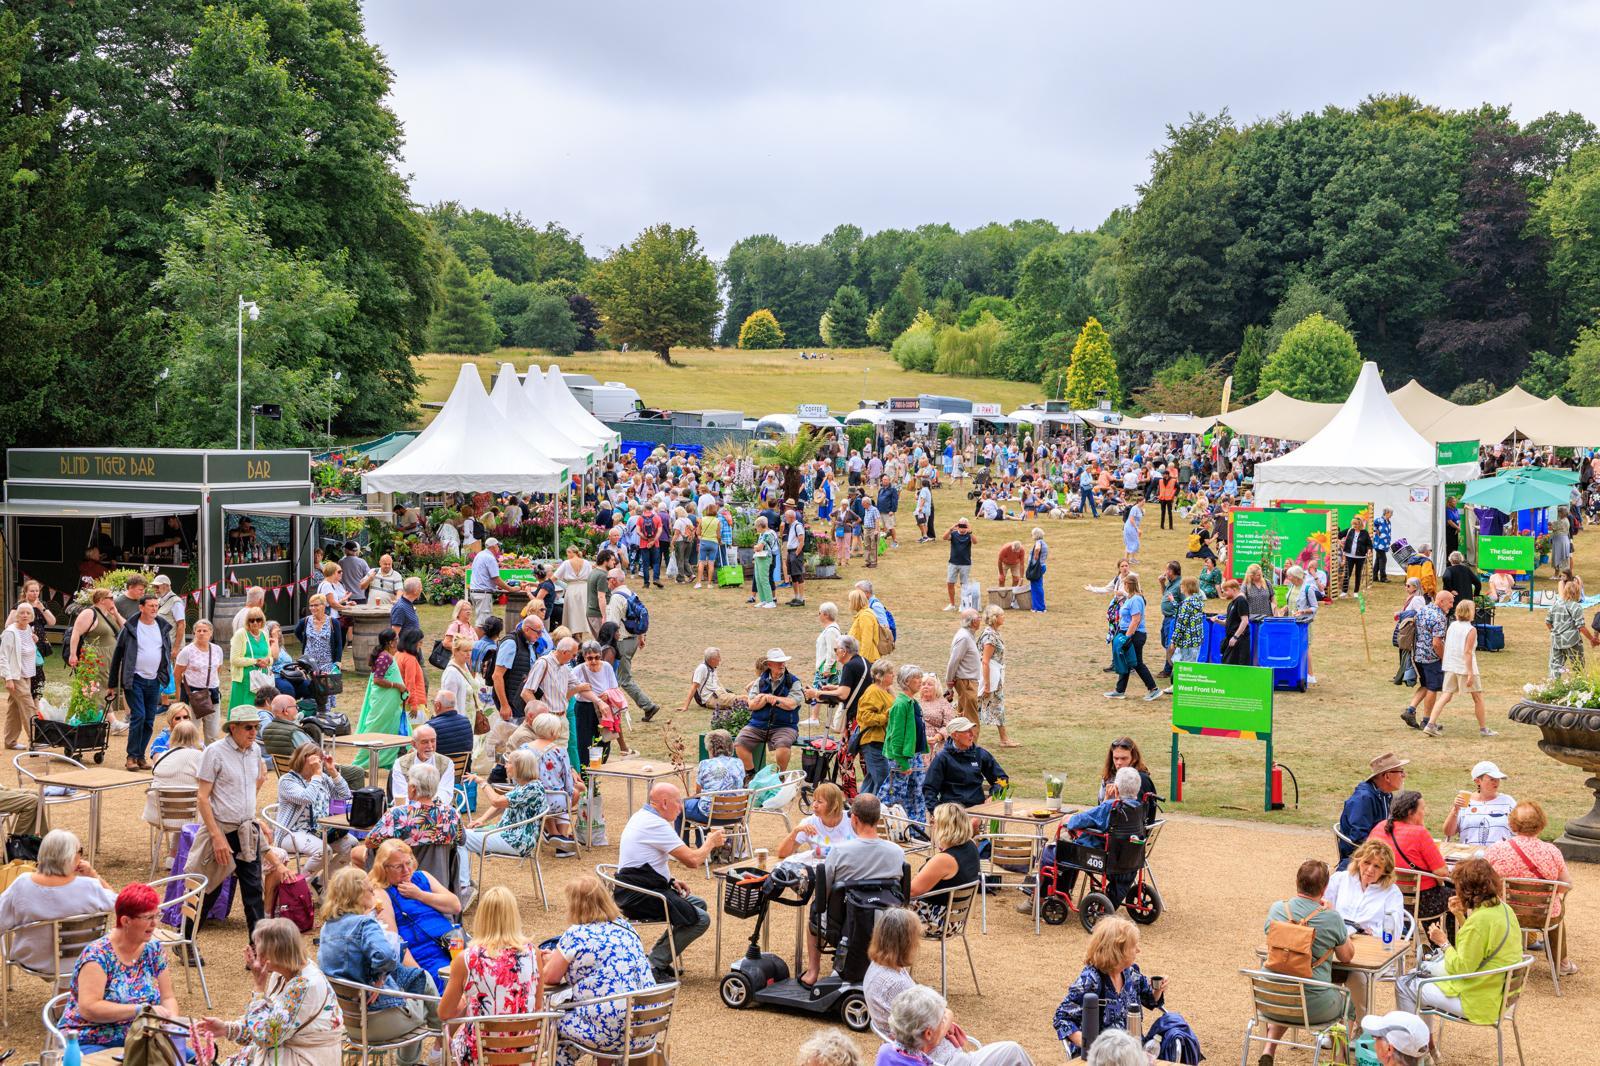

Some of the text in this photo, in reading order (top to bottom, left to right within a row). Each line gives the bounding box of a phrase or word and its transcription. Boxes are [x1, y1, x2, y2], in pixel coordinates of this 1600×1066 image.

[60, 455, 156, 476] BLIND TIGER BAR
[247, 460, 271, 480] BAR
[1087, 858, 1104, 869] 409
